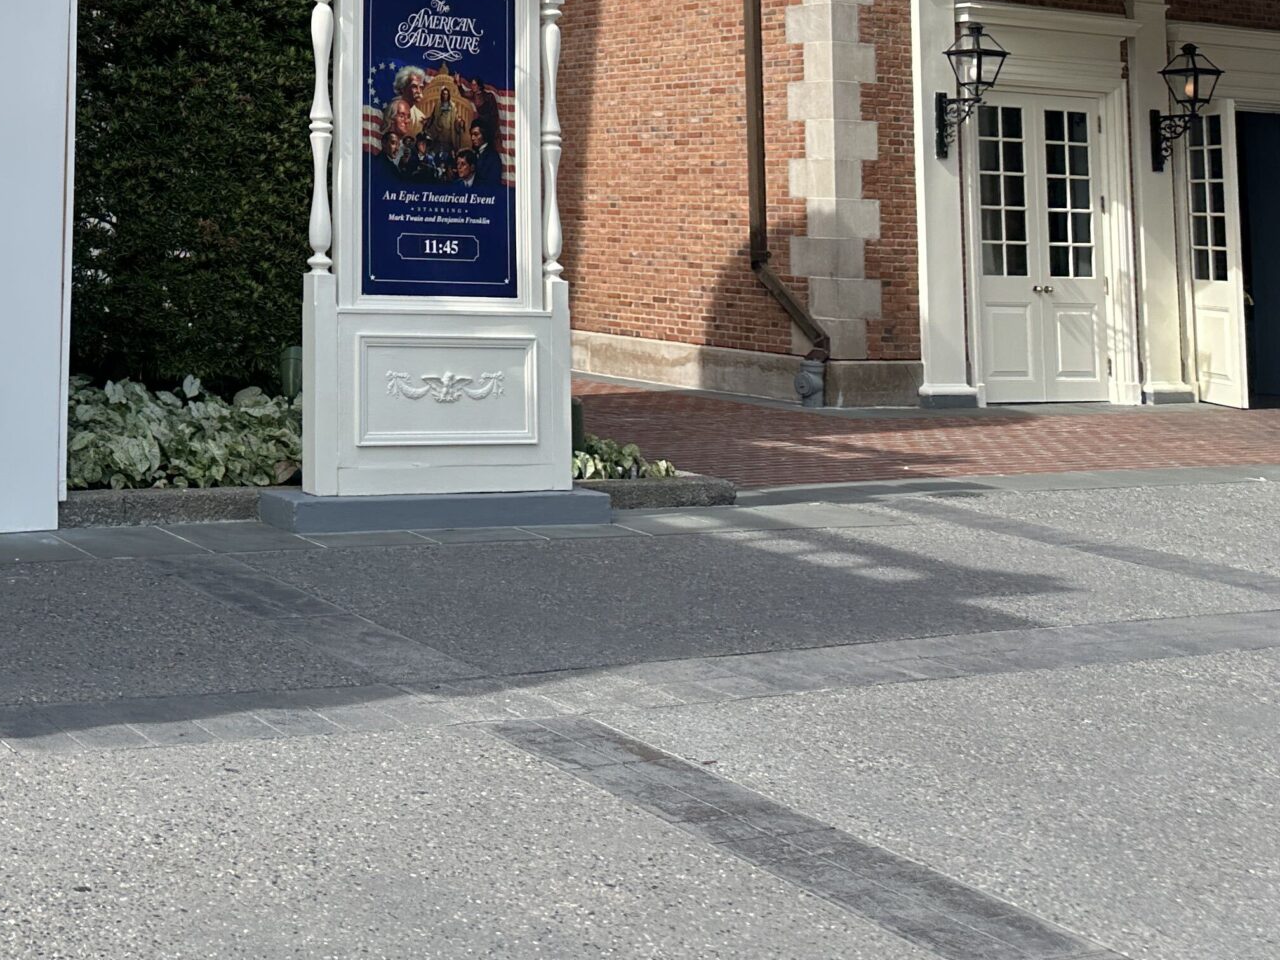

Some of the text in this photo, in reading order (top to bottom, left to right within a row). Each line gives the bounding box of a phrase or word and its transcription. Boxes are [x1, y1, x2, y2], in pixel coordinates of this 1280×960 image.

[382, 190, 495, 205] An Epic Theatrical Event
[388, 213, 404, 221] Mark
[405, 214, 423, 222] Twain
[437, 215, 464, 224] Benjamin
[465, 216, 490, 224] Franklin
[424, 239, 459, 254] 11:45
